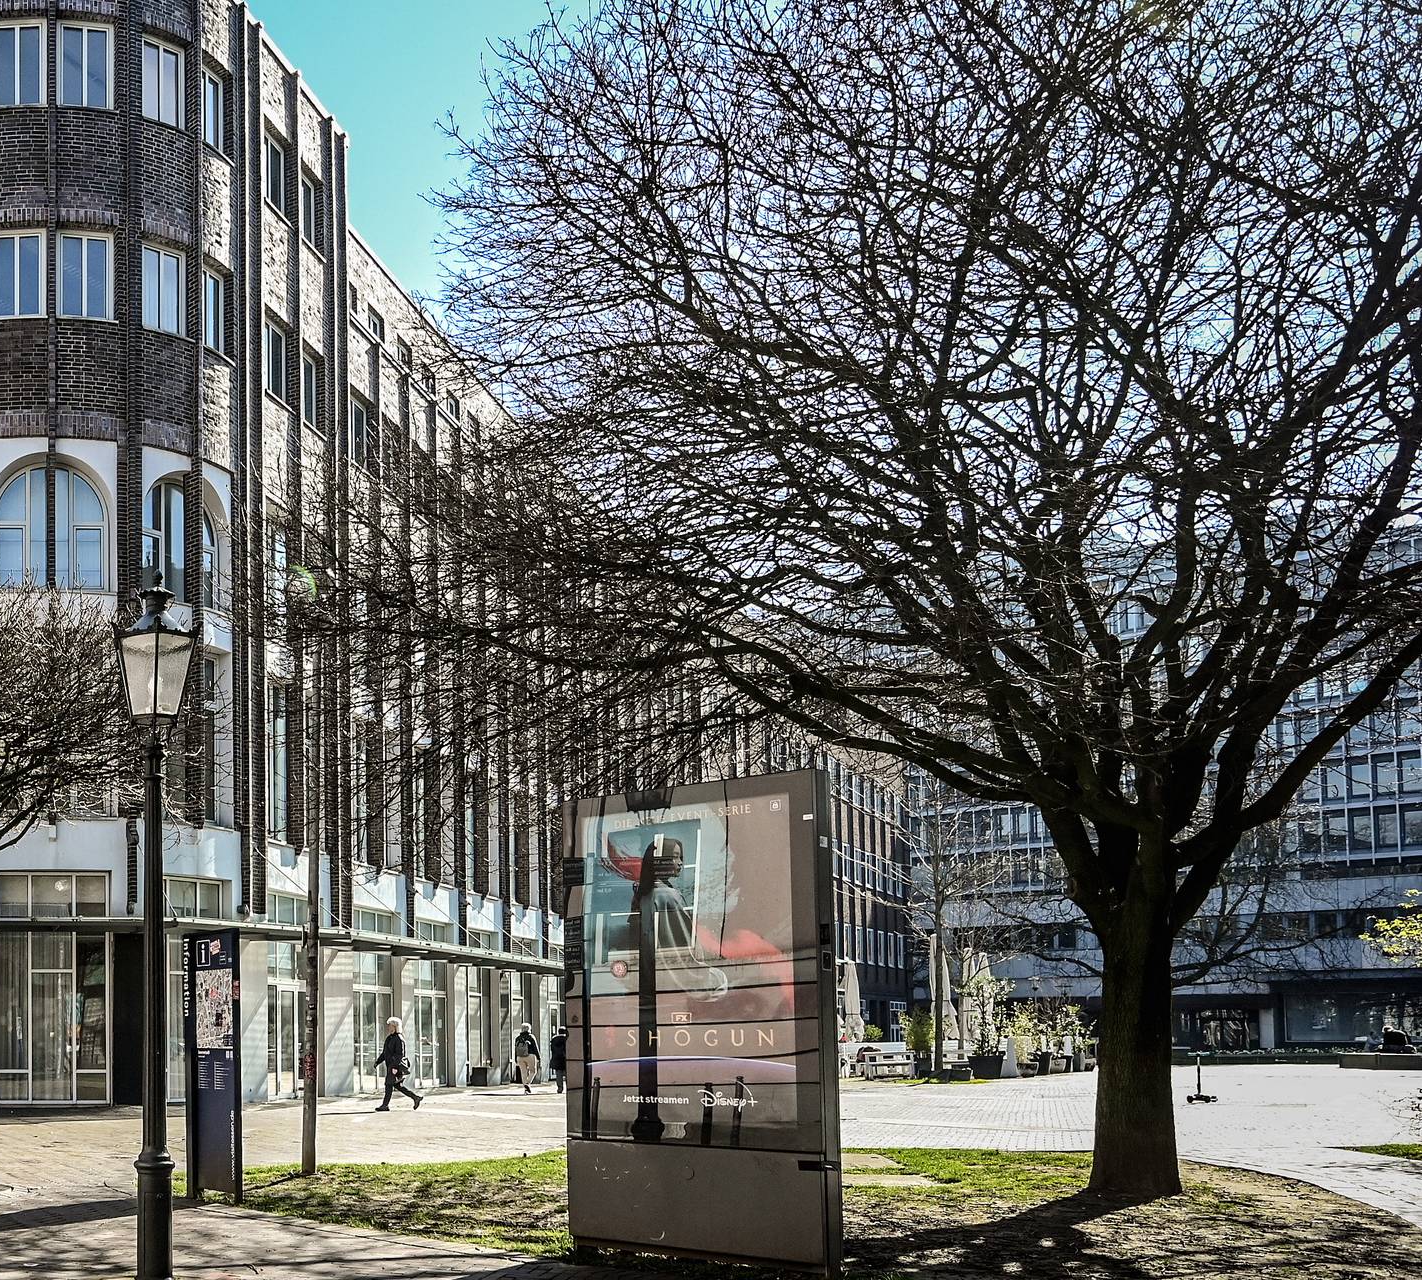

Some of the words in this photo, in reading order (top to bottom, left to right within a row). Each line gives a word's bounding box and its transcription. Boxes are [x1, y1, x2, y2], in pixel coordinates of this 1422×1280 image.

[675, 1014, 688, 1022] FX
[623, 1094, 644, 1103] Jetzt
[645, 1095, 689, 1105] streamen
[698, 1081, 758, 1112] Disney+
